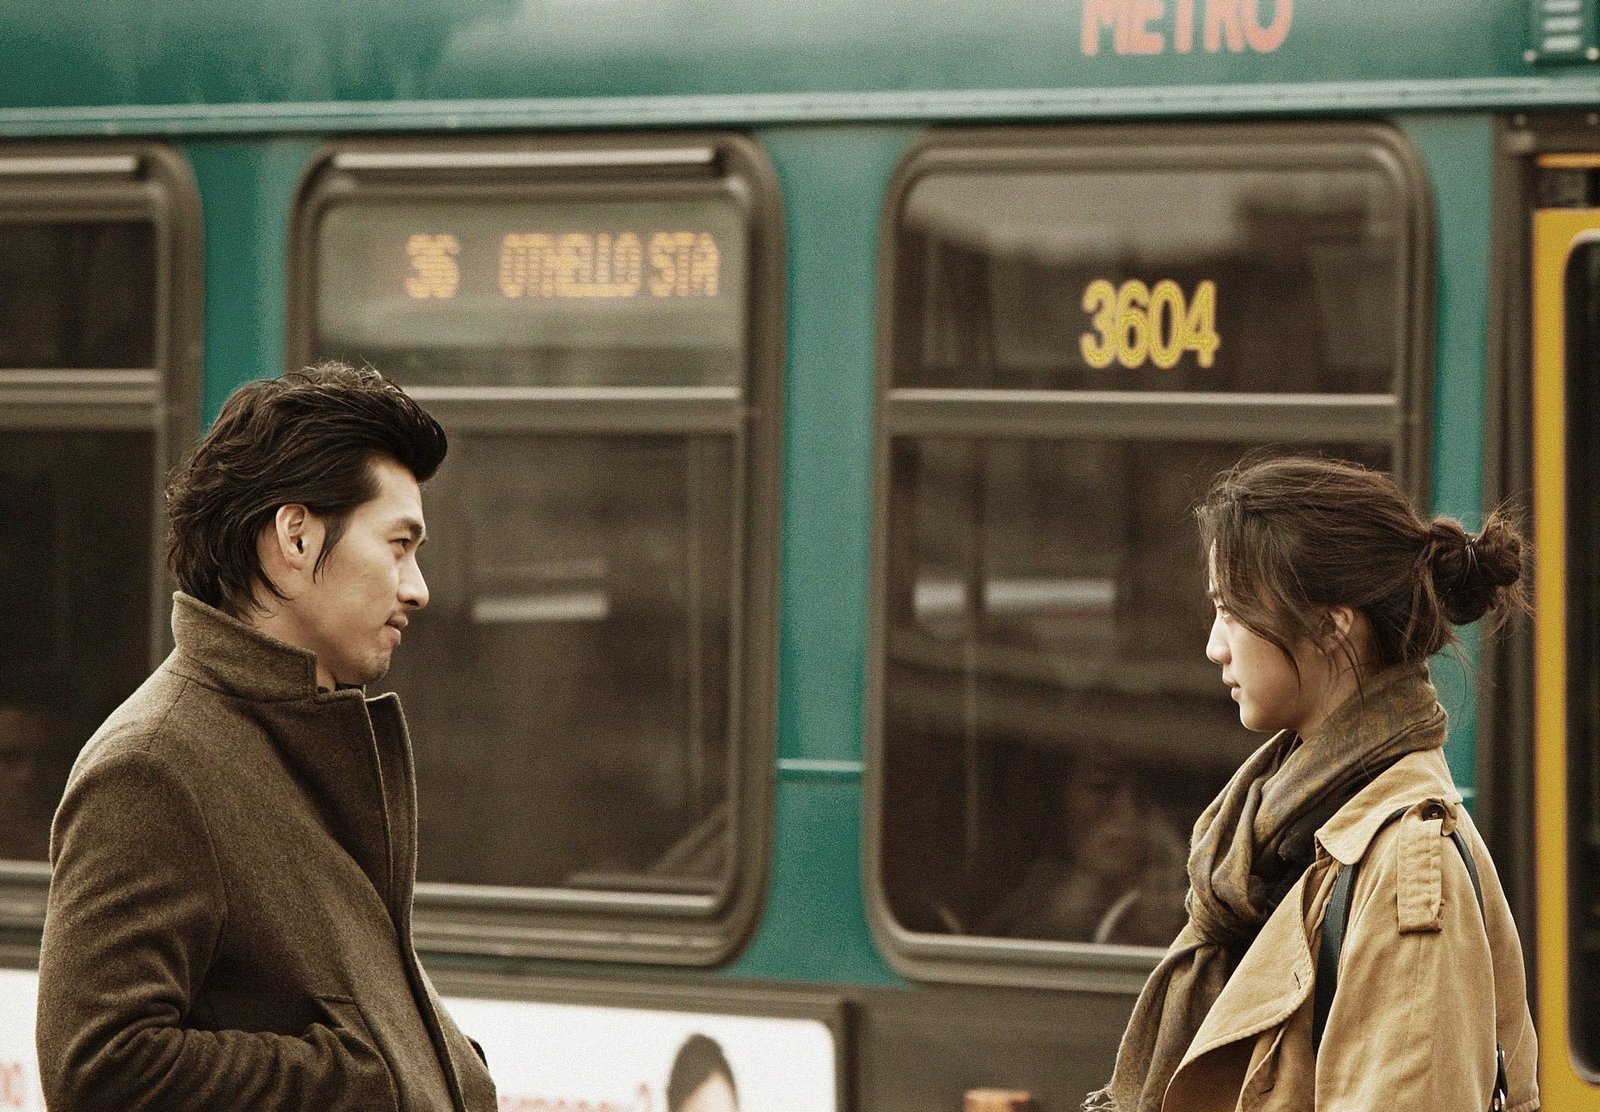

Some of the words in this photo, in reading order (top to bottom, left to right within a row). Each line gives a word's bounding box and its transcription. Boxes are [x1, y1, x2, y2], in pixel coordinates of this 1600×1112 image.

[1081, 0, 1294, 55] METRO
[403, 234, 460, 299] 36
[501, 232, 643, 298] OTHELLO
[650, 231, 720, 297] STA
[1080, 279, 1220, 369] 3604
